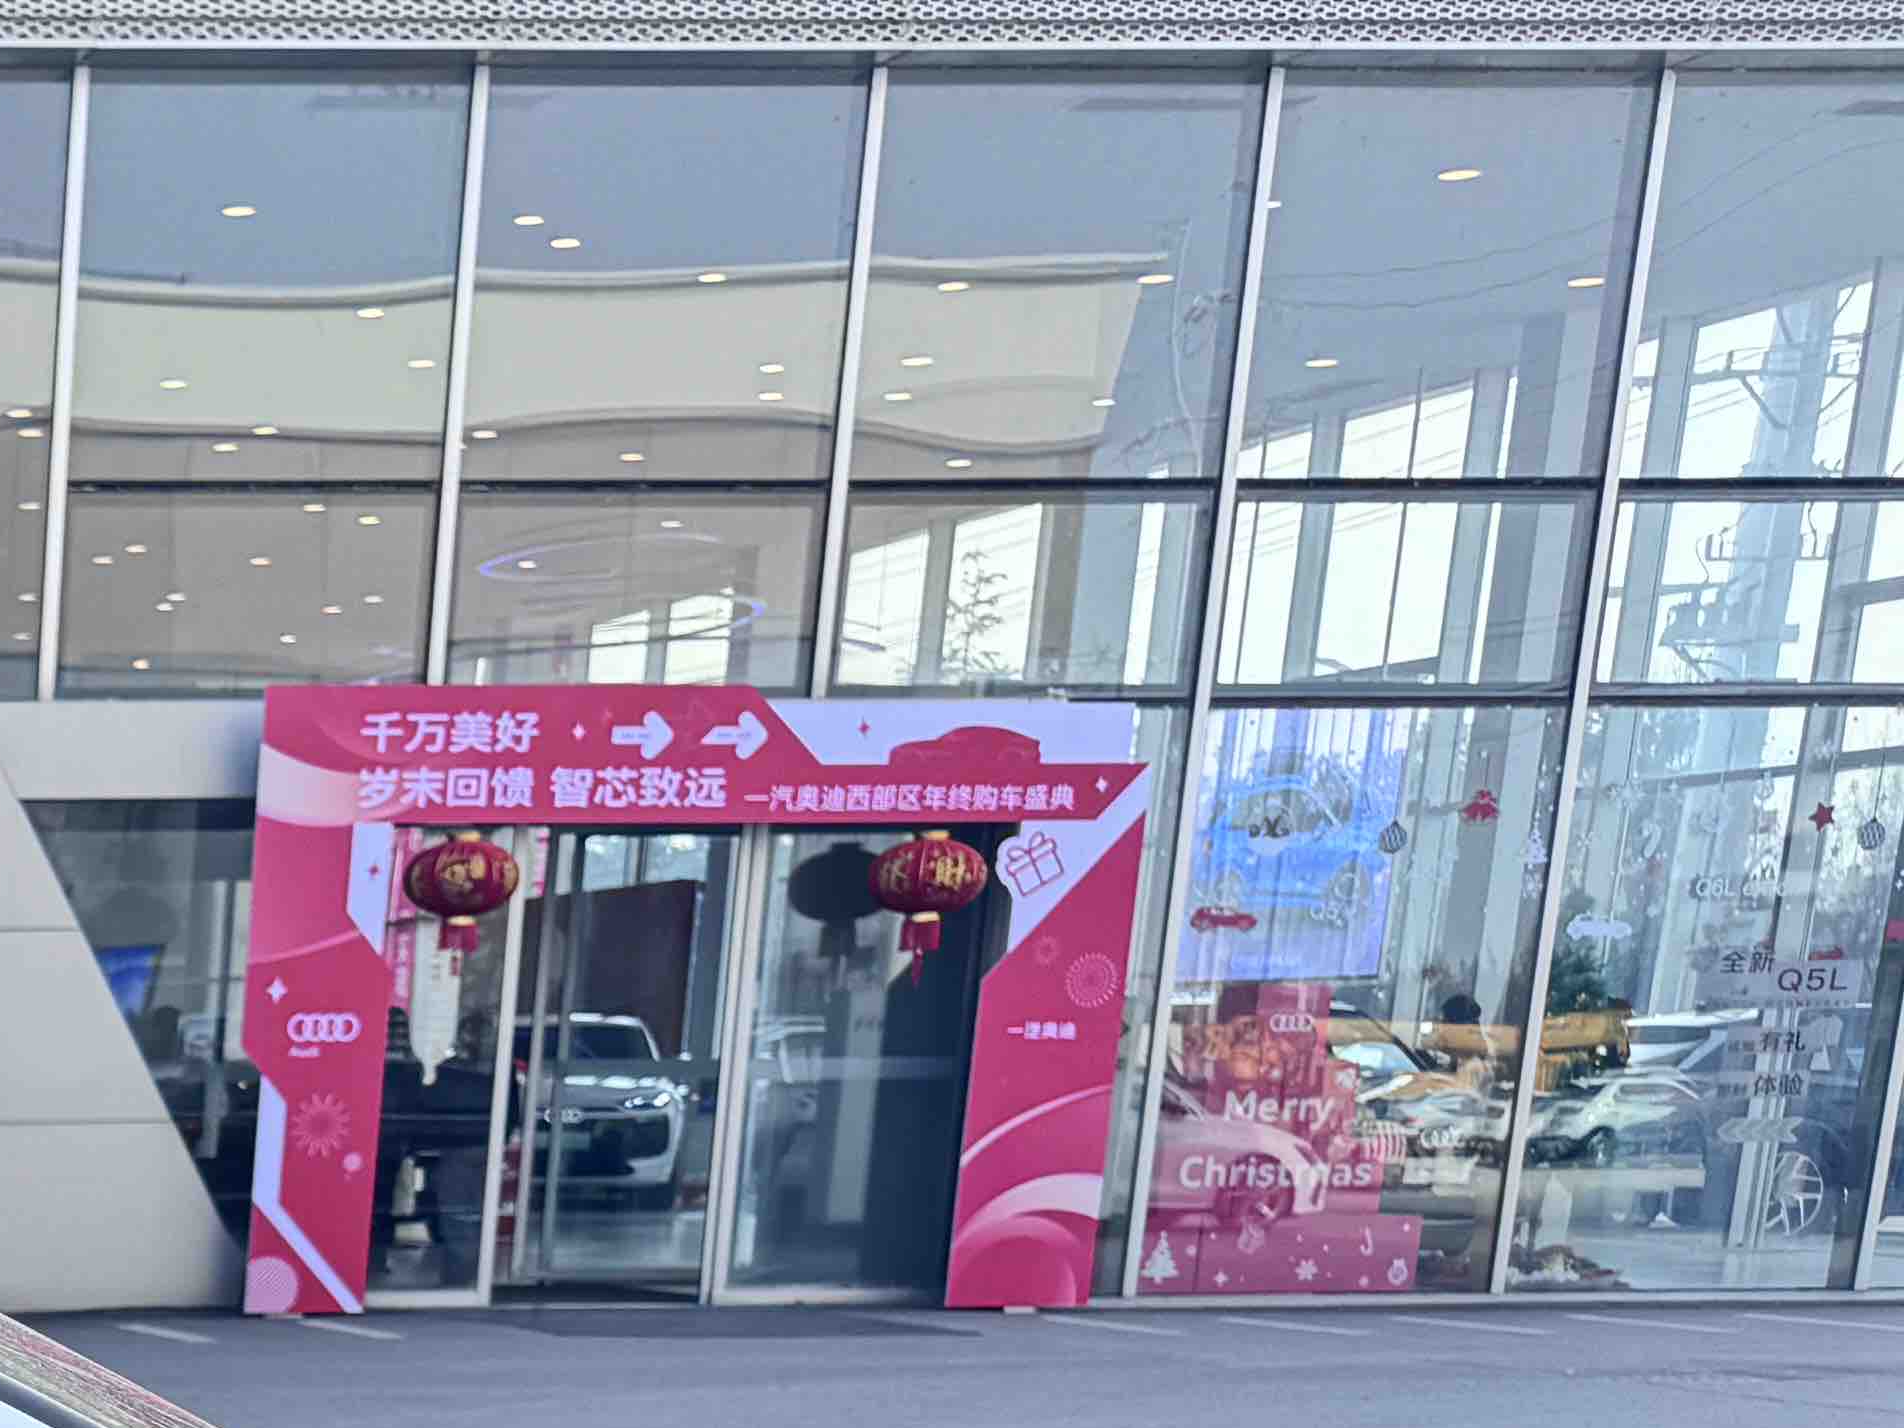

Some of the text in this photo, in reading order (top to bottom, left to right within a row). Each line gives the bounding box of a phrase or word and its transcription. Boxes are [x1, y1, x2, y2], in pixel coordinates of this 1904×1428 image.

[360, 712, 540, 754] 千万美好
[357, 767, 727, 808] 岁末回馈 智芯致远
[743, 783, 1076, 812] 一汽奥迪西部区年终购车盛典
[1720, 950, 1849, 993] 全新 Q5L
[1224, 1090, 1334, 1130] Merry
